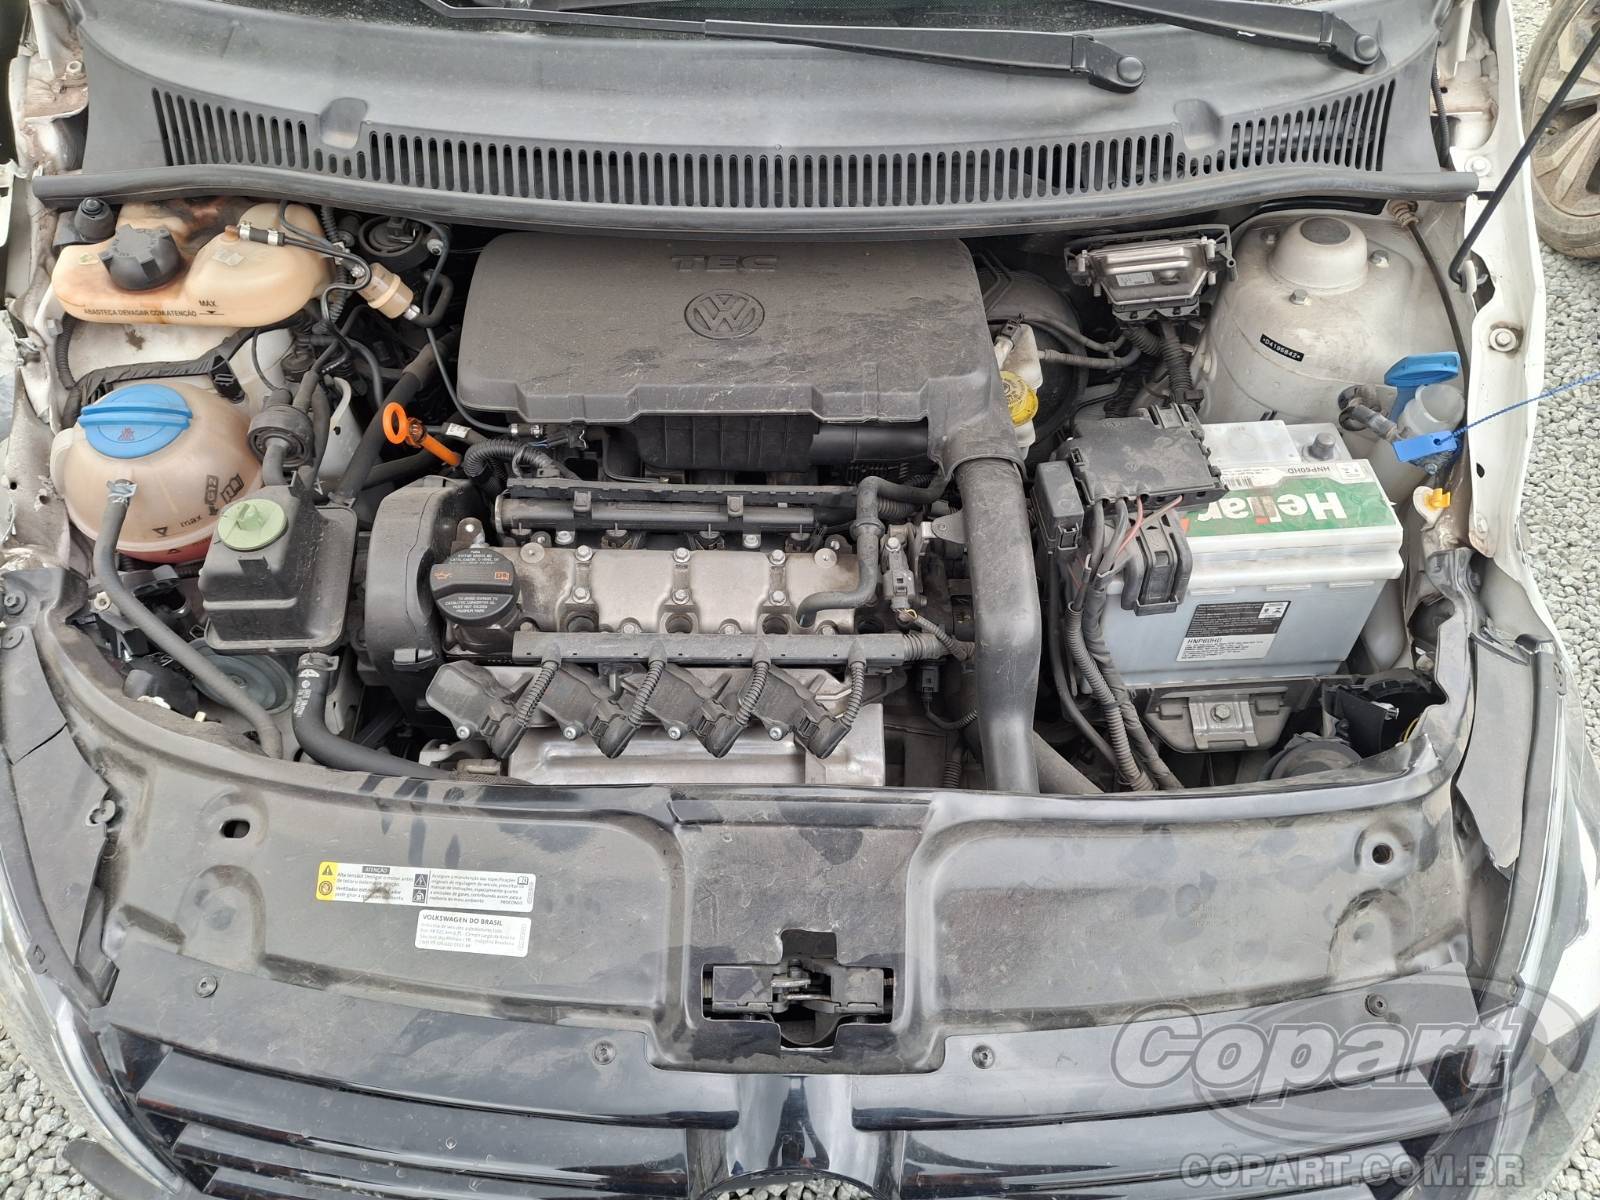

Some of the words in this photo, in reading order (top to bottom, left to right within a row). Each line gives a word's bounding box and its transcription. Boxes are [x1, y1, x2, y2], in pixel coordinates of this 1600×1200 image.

[671, 255, 777, 271] TEC
[1197, 492, 1348, 525] Heliar
[422, 914, 467, 923] VOLKSWAGEN
[480, 918, 503, 926] BRASIL
